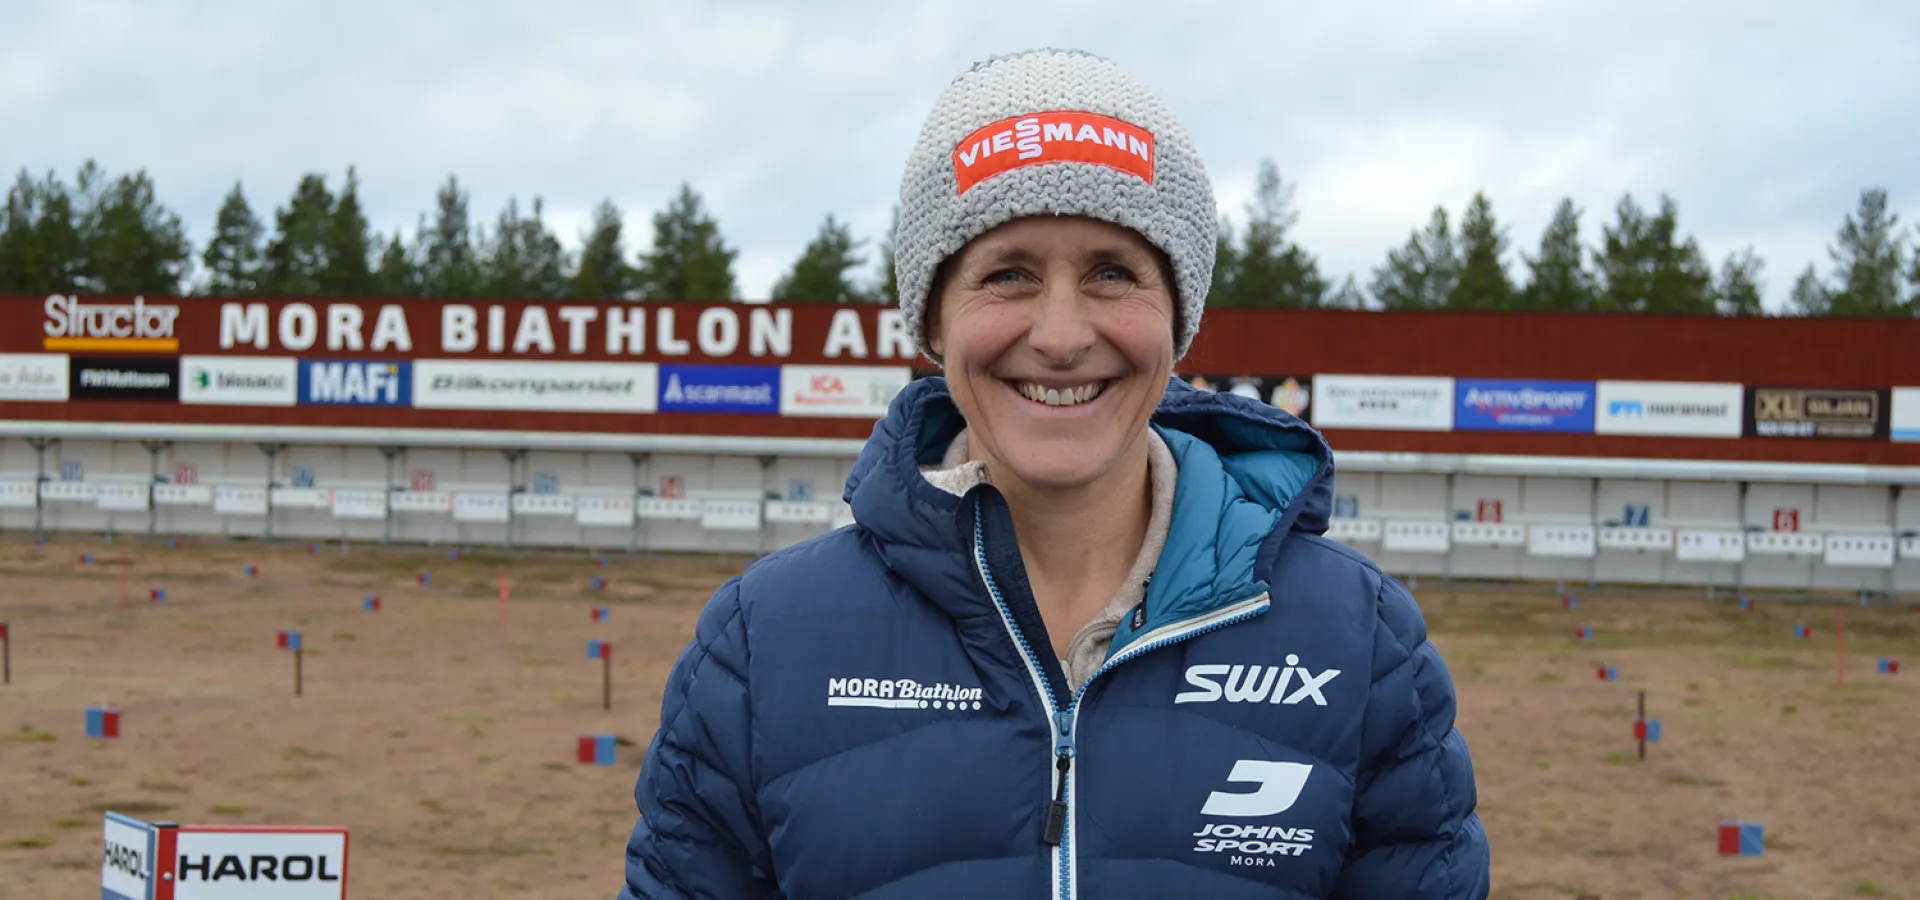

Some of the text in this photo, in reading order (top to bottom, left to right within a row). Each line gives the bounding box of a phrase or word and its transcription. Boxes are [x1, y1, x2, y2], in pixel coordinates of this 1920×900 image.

[959, 118, 1149, 168] VIESSMANN
[43, 295, 180, 337] Structor
[219, 302, 412, 350] MORA
[441, 304, 793, 356] BIATHLON
[431, 374, 635, 396] Bilkompaniet
[810, 373, 845, 394] ICA
[828, 677, 983, 700] MORA Biathlon
[1192, 823, 1315, 842] JOHNS
[103, 840, 149, 880] HAROL
[1193, 838, 1313, 857] SPORT
[178, 854, 339, 882] HAROL
